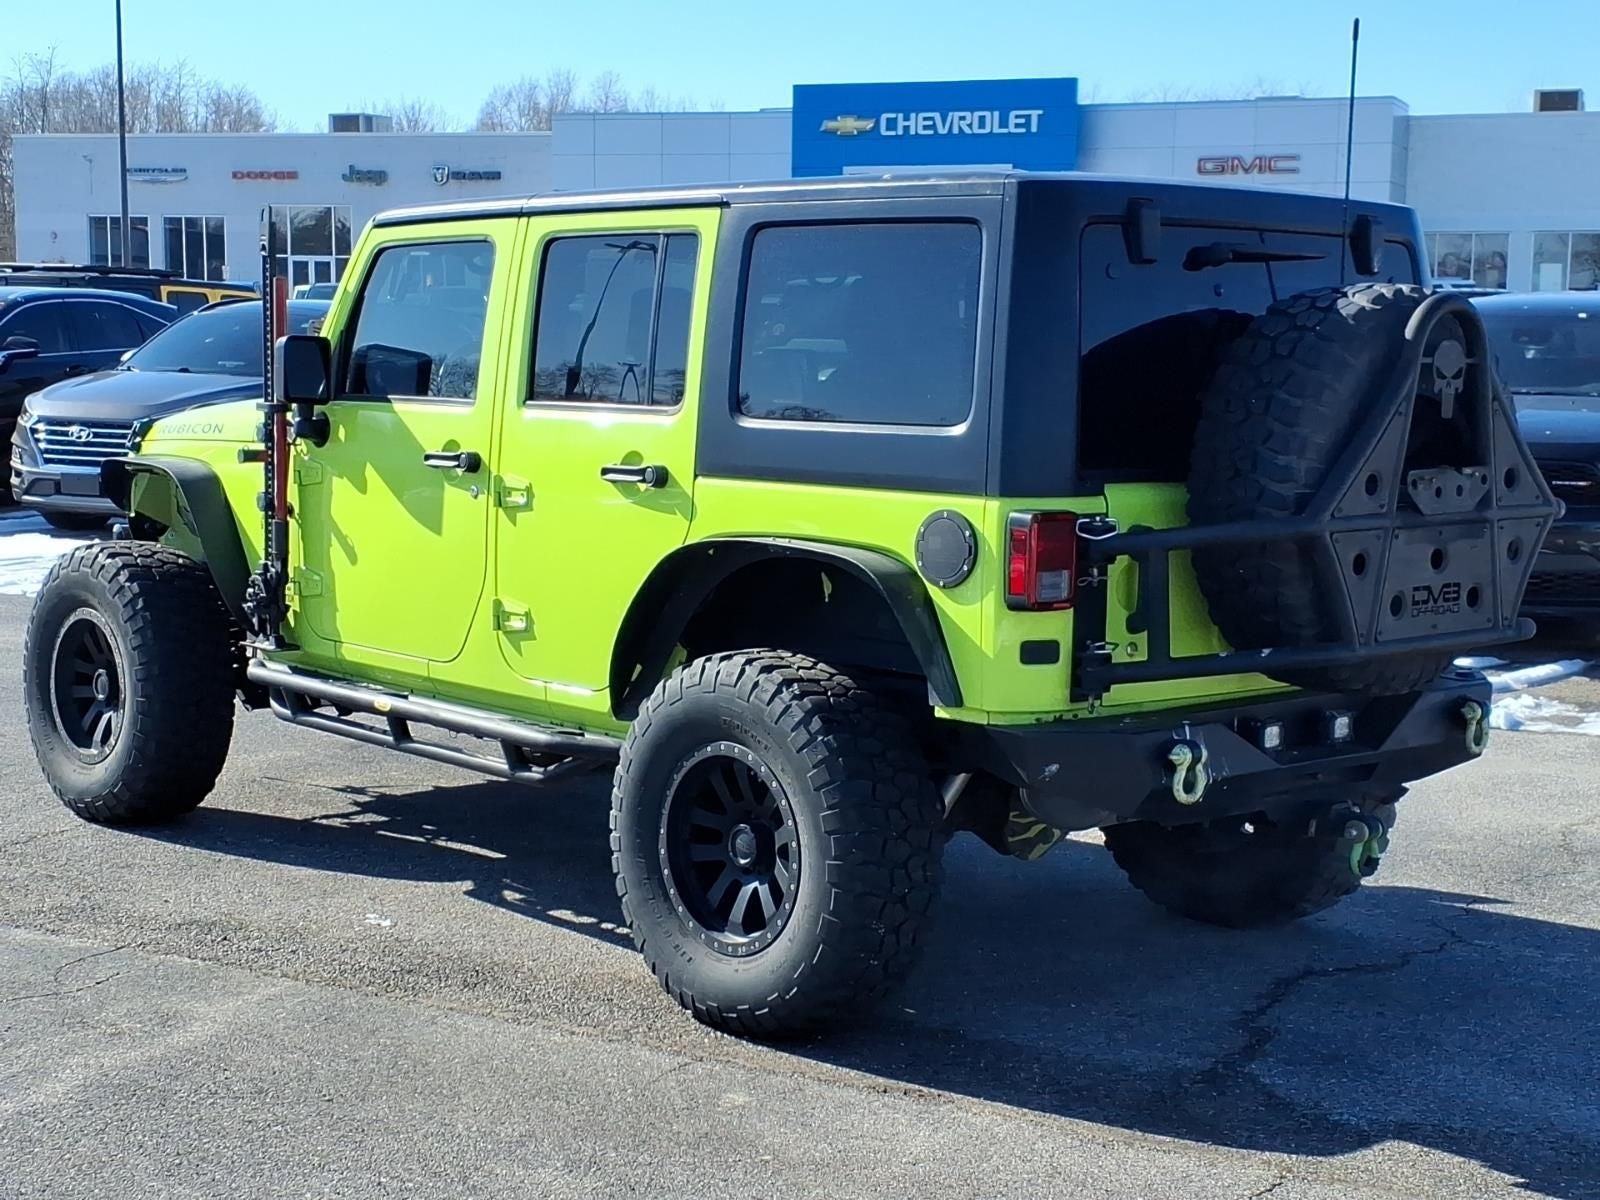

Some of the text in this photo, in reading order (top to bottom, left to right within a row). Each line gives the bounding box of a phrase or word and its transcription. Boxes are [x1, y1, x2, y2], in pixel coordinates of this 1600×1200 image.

[880, 110, 1043, 135] CHEVROLET
[1197, 153, 1301, 175] GMC
[231, 170, 298, 180] DODGE
[341, 164, 388, 186] Jeep
[451, 170, 501, 181] RAM
[159, 423, 225, 434] RUBICON
